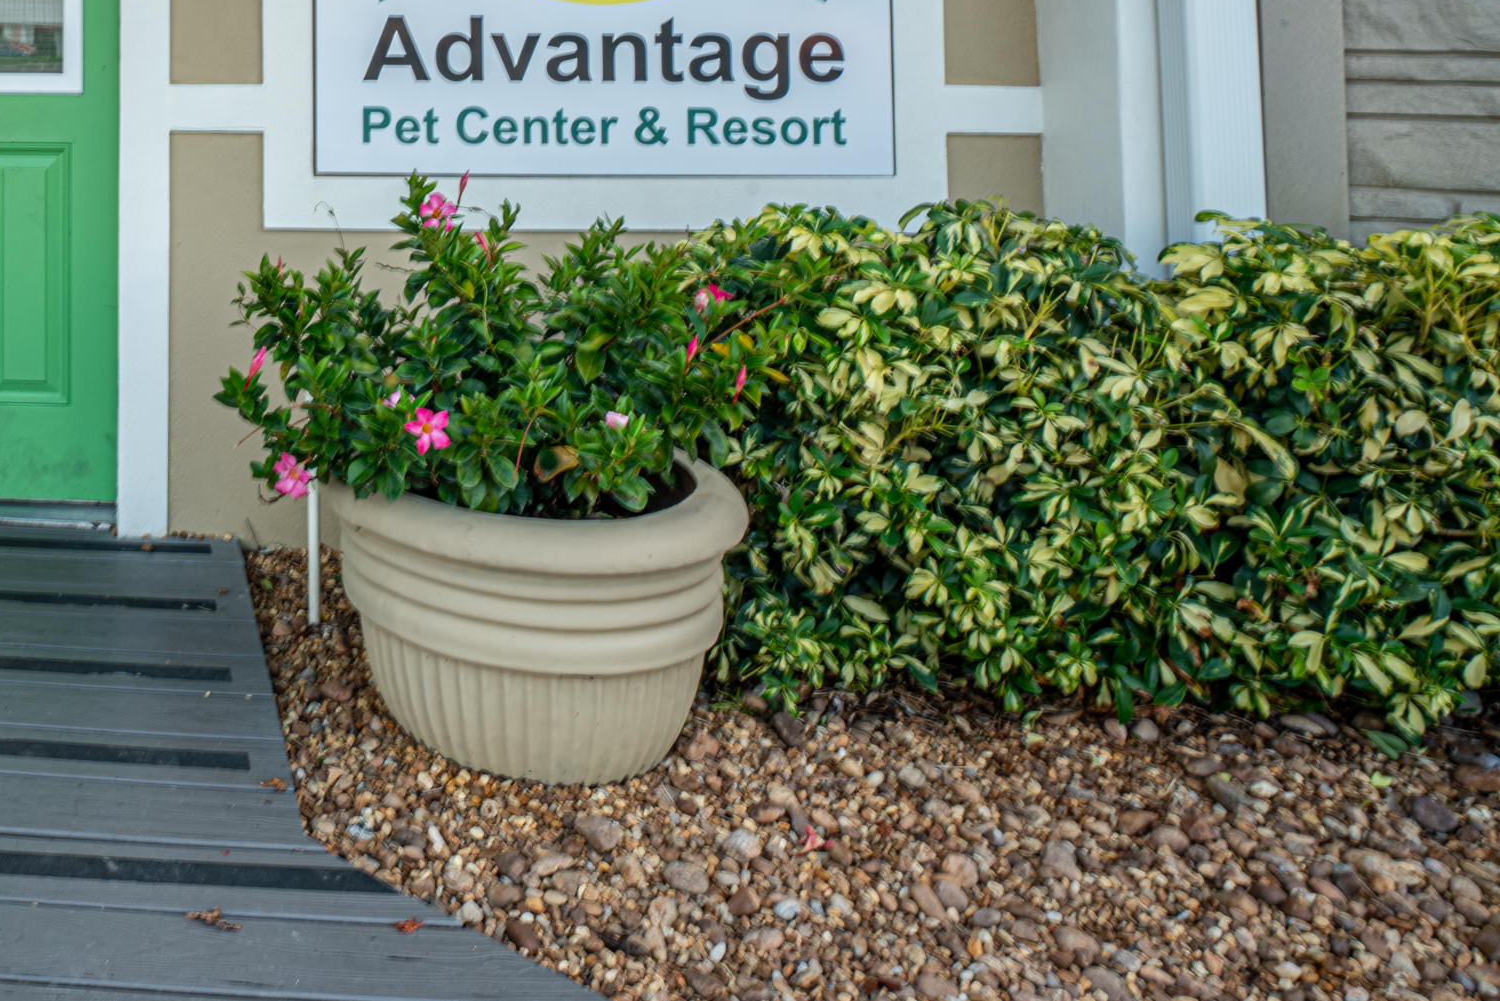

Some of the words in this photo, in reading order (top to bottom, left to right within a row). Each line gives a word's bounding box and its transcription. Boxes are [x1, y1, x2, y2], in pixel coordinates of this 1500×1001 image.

[362, 14, 847, 101] Advantage
[361, 105, 441, 146] Pet
[455, 104, 619, 146] Center
[634, 106, 670, 147] &
[686, 105, 848, 147] Resort
